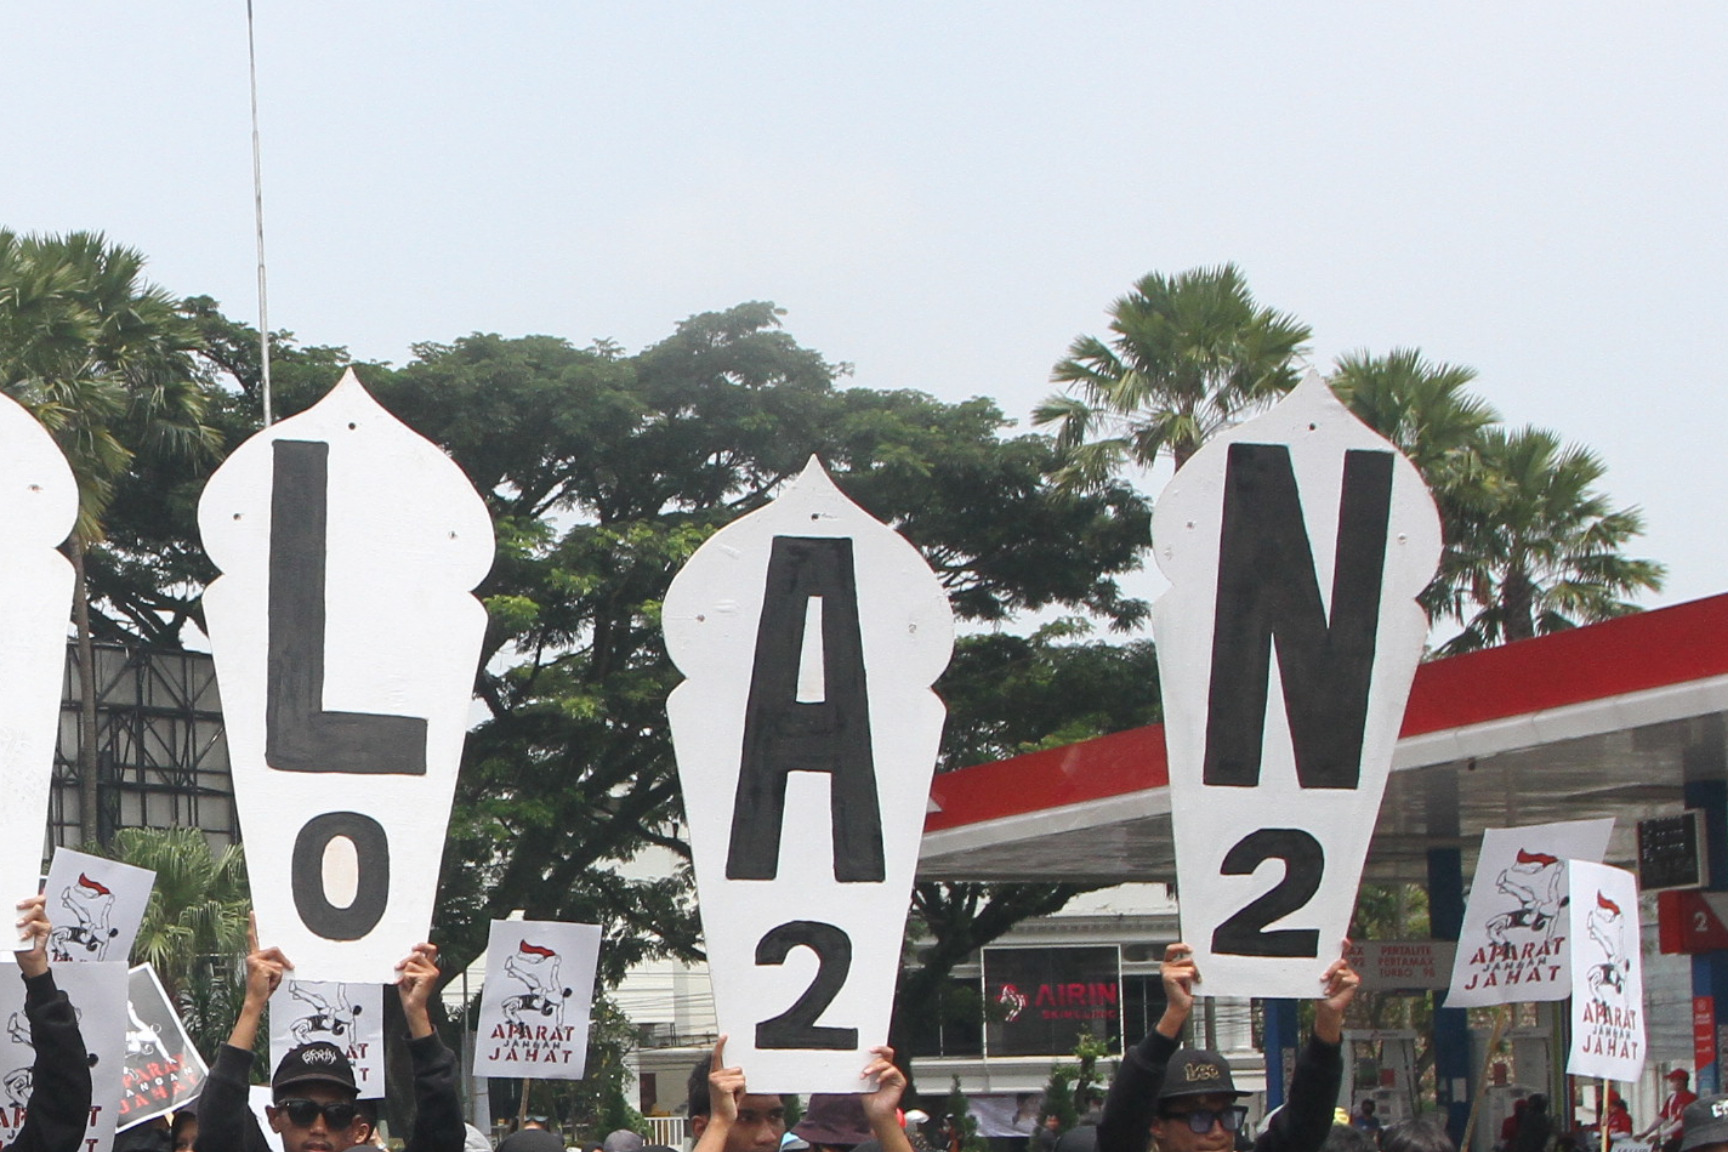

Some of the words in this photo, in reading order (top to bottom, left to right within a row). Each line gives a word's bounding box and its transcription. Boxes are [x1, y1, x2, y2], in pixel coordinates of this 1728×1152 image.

[265, 439, 428, 775] L
[1202, 442, 1395, 790] N
[724, 535, 886, 882] A
[1210, 827, 1326, 958] 2
[1469, 937, 1566, 965] APARAT
[752, 919, 859, 1052] 2
[1464, 965, 1561, 990] JAHAT
[1035, 982, 1117, 1007] AIRIN
[1583, 1001, 1636, 1031] APARAT
[490, 1024, 575, 1042] APARAT
[1582, 1035, 1638, 1060] JAHAT
[123, 1053, 186, 1088] PARAT
[488, 1048, 573, 1064] JAHAT
[125, 1066, 194, 1099] ANGAN
